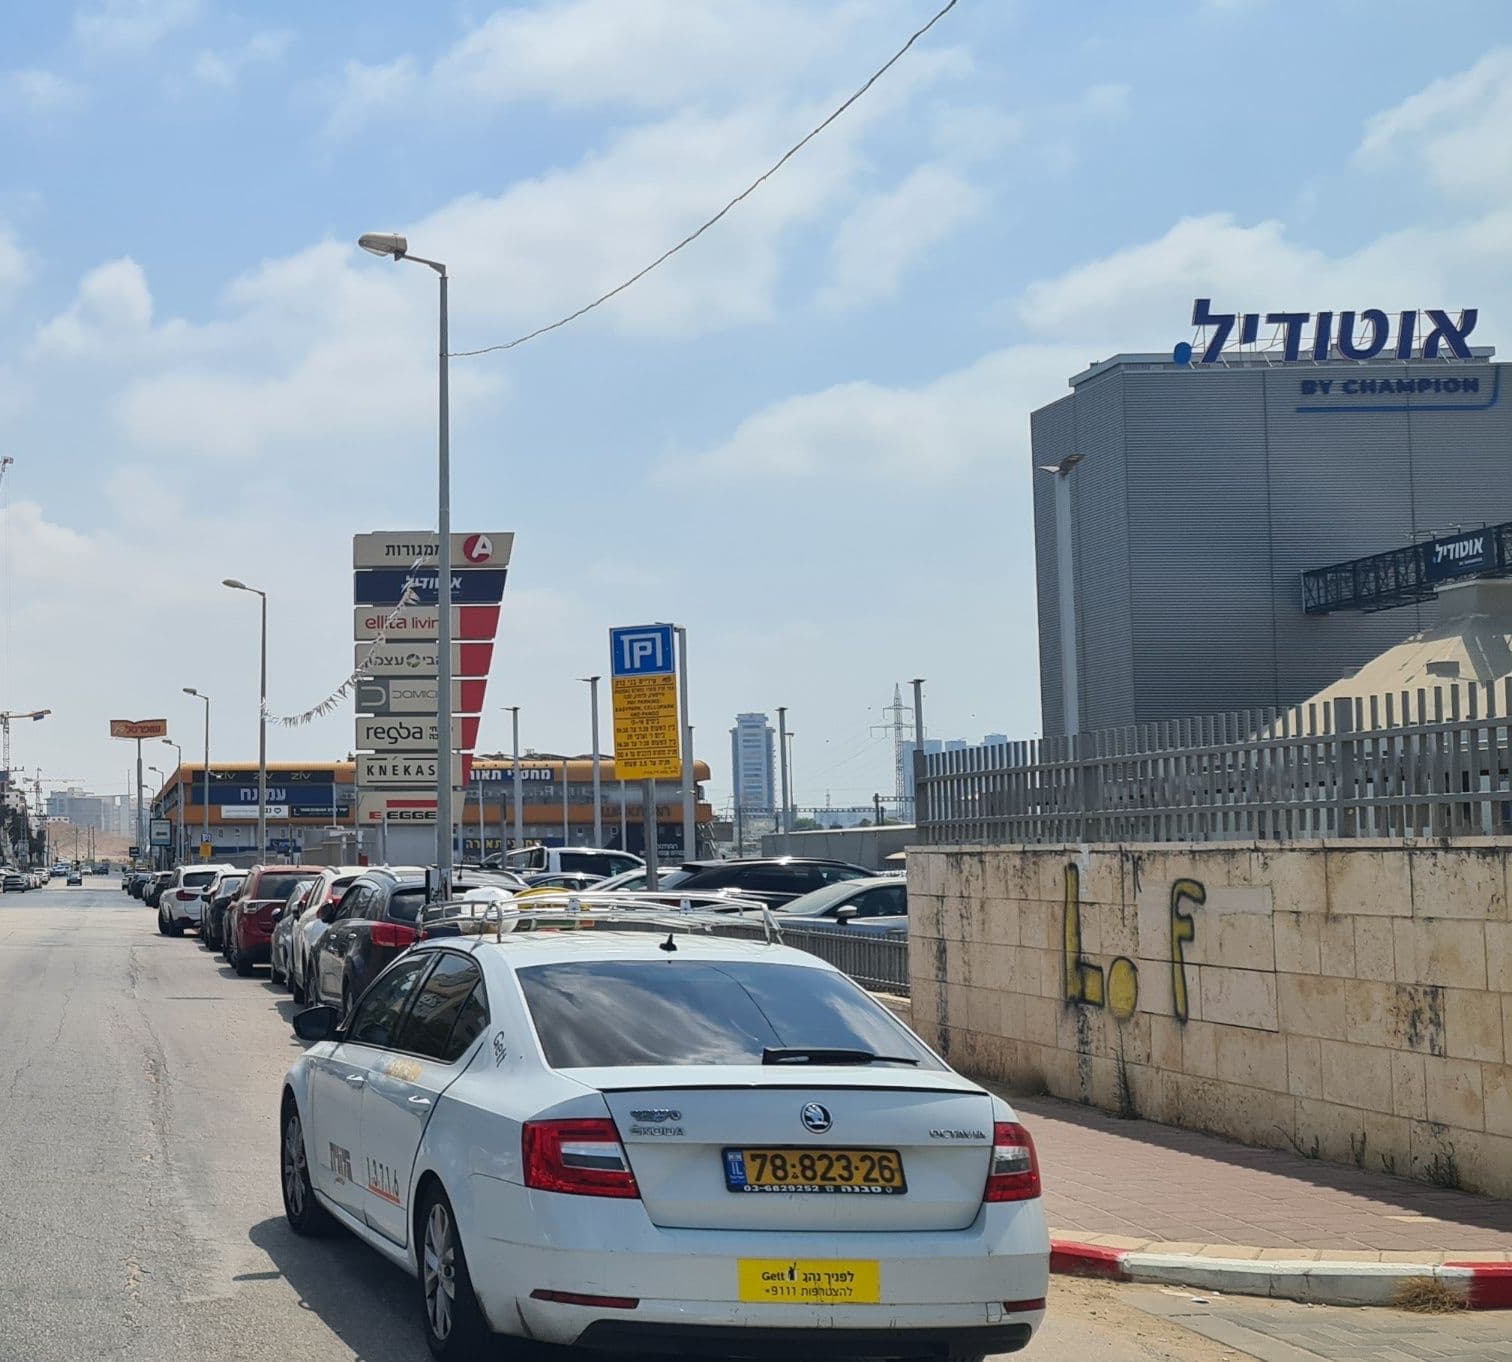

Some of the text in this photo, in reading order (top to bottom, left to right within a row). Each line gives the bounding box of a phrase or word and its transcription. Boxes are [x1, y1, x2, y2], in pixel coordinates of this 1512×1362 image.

[1301, 377, 1480, 395] BY CHAMPION
[366, 721, 423, 744] regba
[240, 788, 287, 801] עמנח
[387, 811, 438, 820] EGGE
[761, 1271, 785, 1281] Gett
